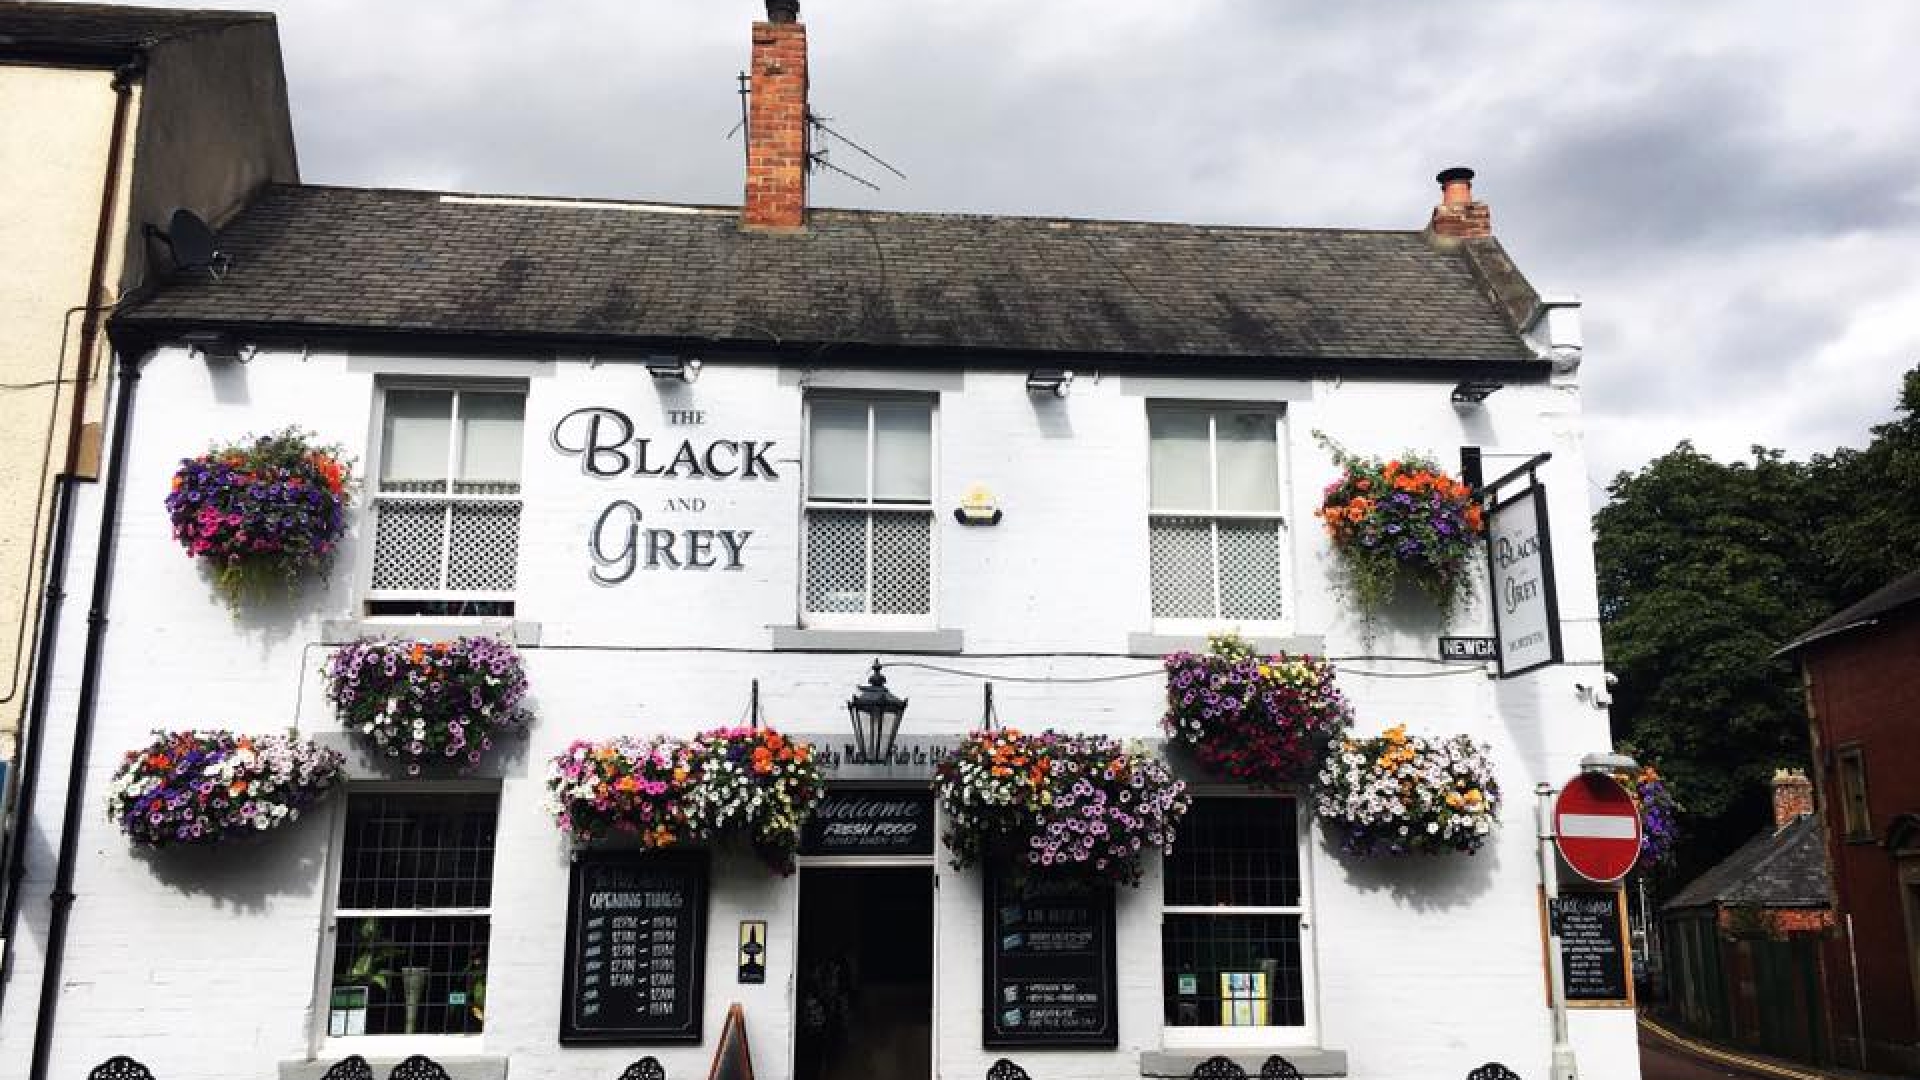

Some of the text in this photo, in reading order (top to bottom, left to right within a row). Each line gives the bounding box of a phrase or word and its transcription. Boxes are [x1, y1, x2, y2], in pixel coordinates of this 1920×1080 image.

[668, 410, 706, 425] THE
[550, 406, 779, 480] BLACK
[664, 498, 706, 511] AND
[588, 499, 754, 588] GREY
